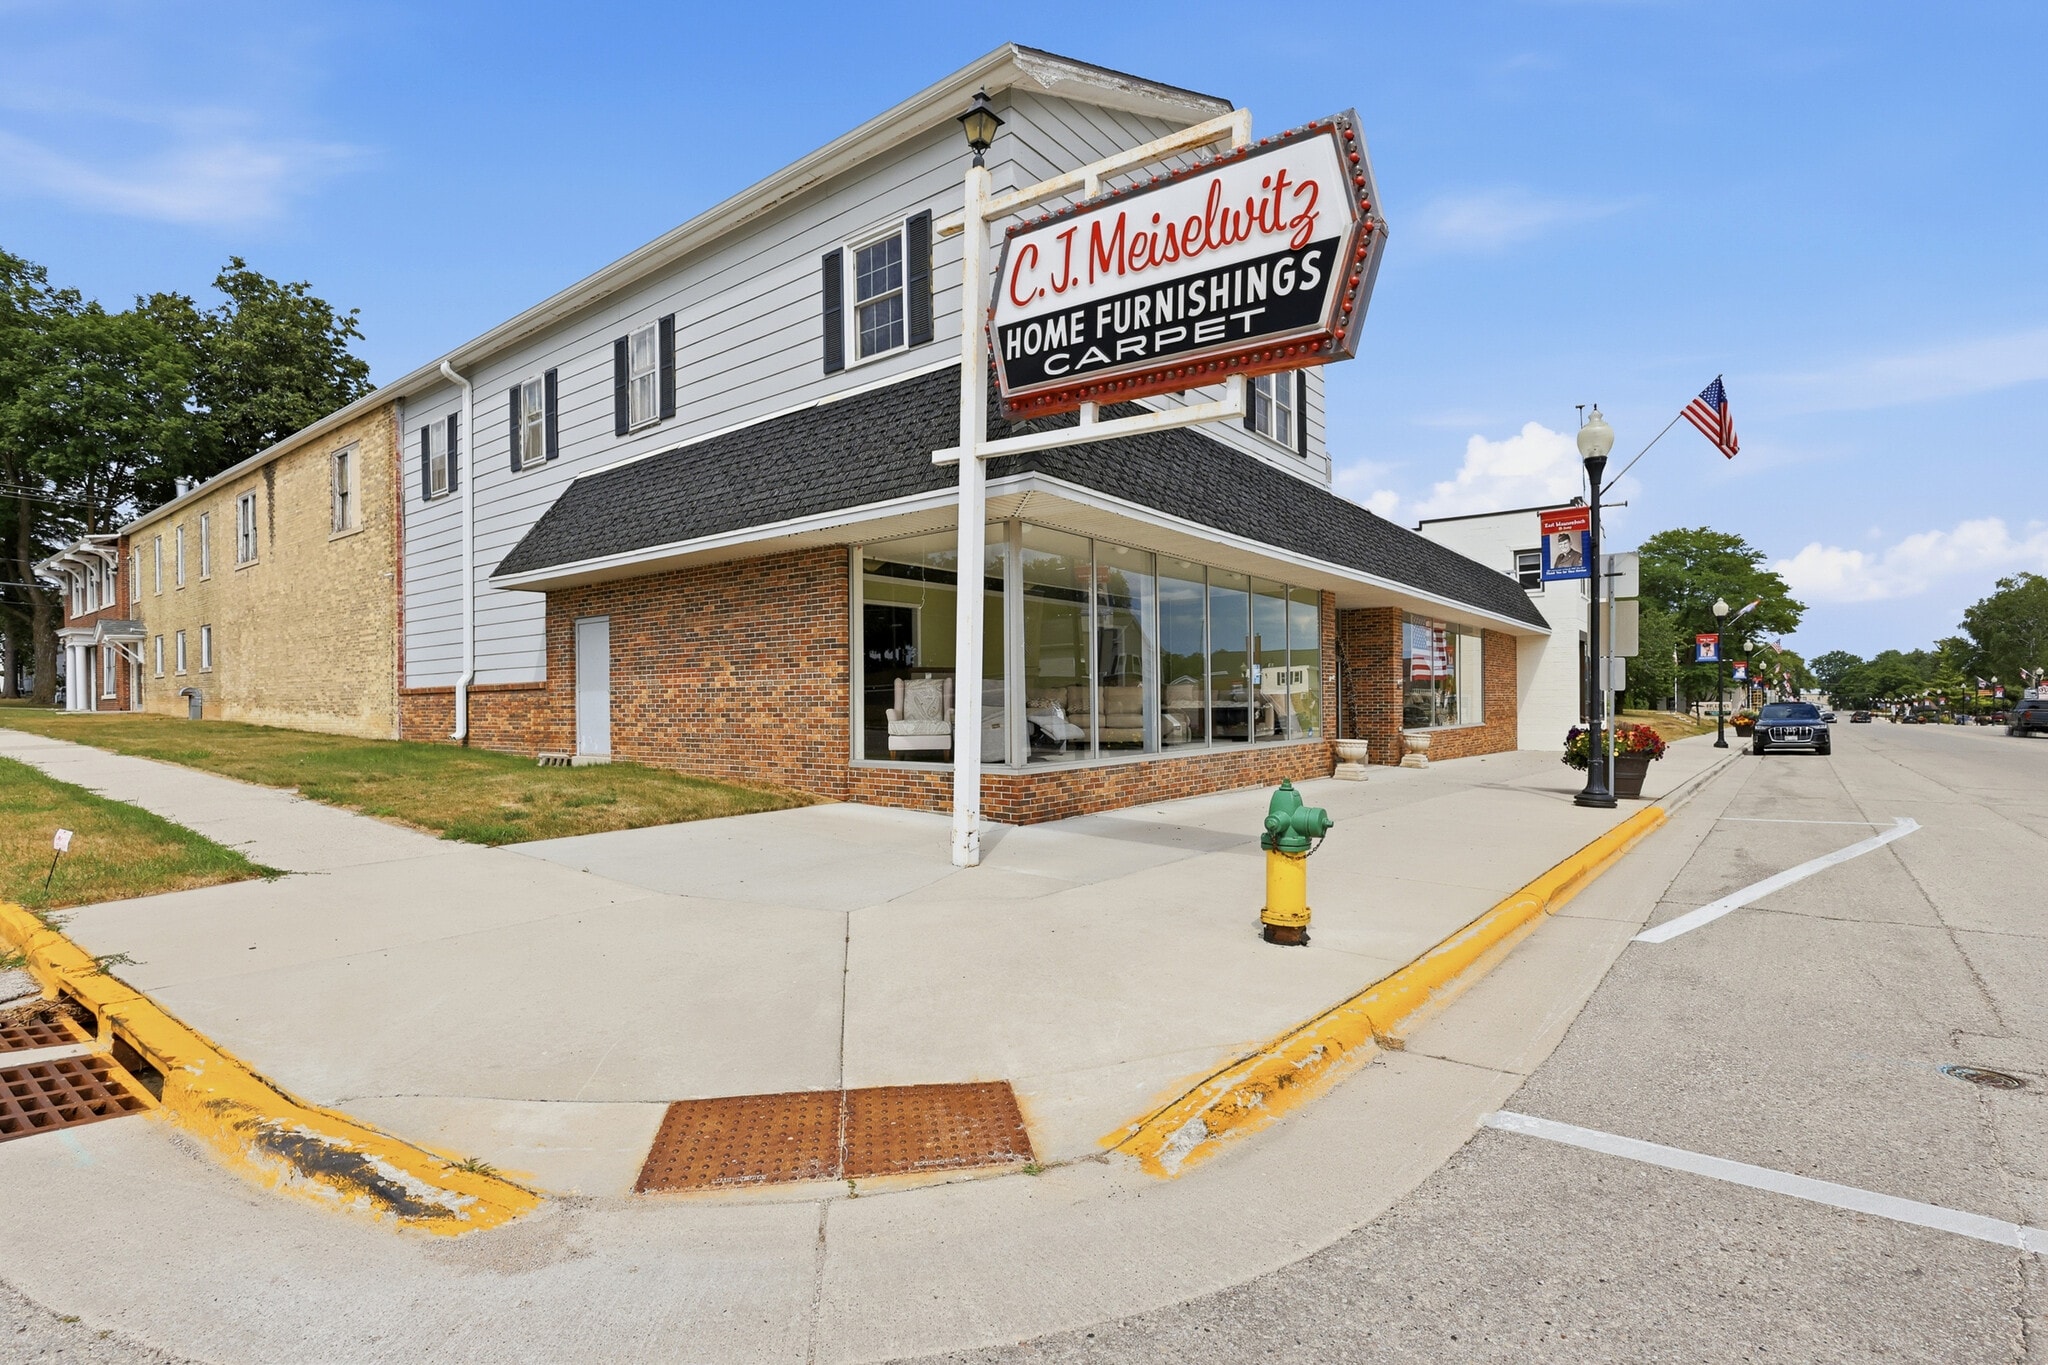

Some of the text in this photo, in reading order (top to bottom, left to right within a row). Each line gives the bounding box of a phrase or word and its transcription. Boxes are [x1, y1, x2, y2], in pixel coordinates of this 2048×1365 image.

[1089, 168, 1319, 284] Meiselwitz
[1006, 250, 1322, 361] HOME FURNISHINGS
[1043, 307, 1266, 376] CARPET
